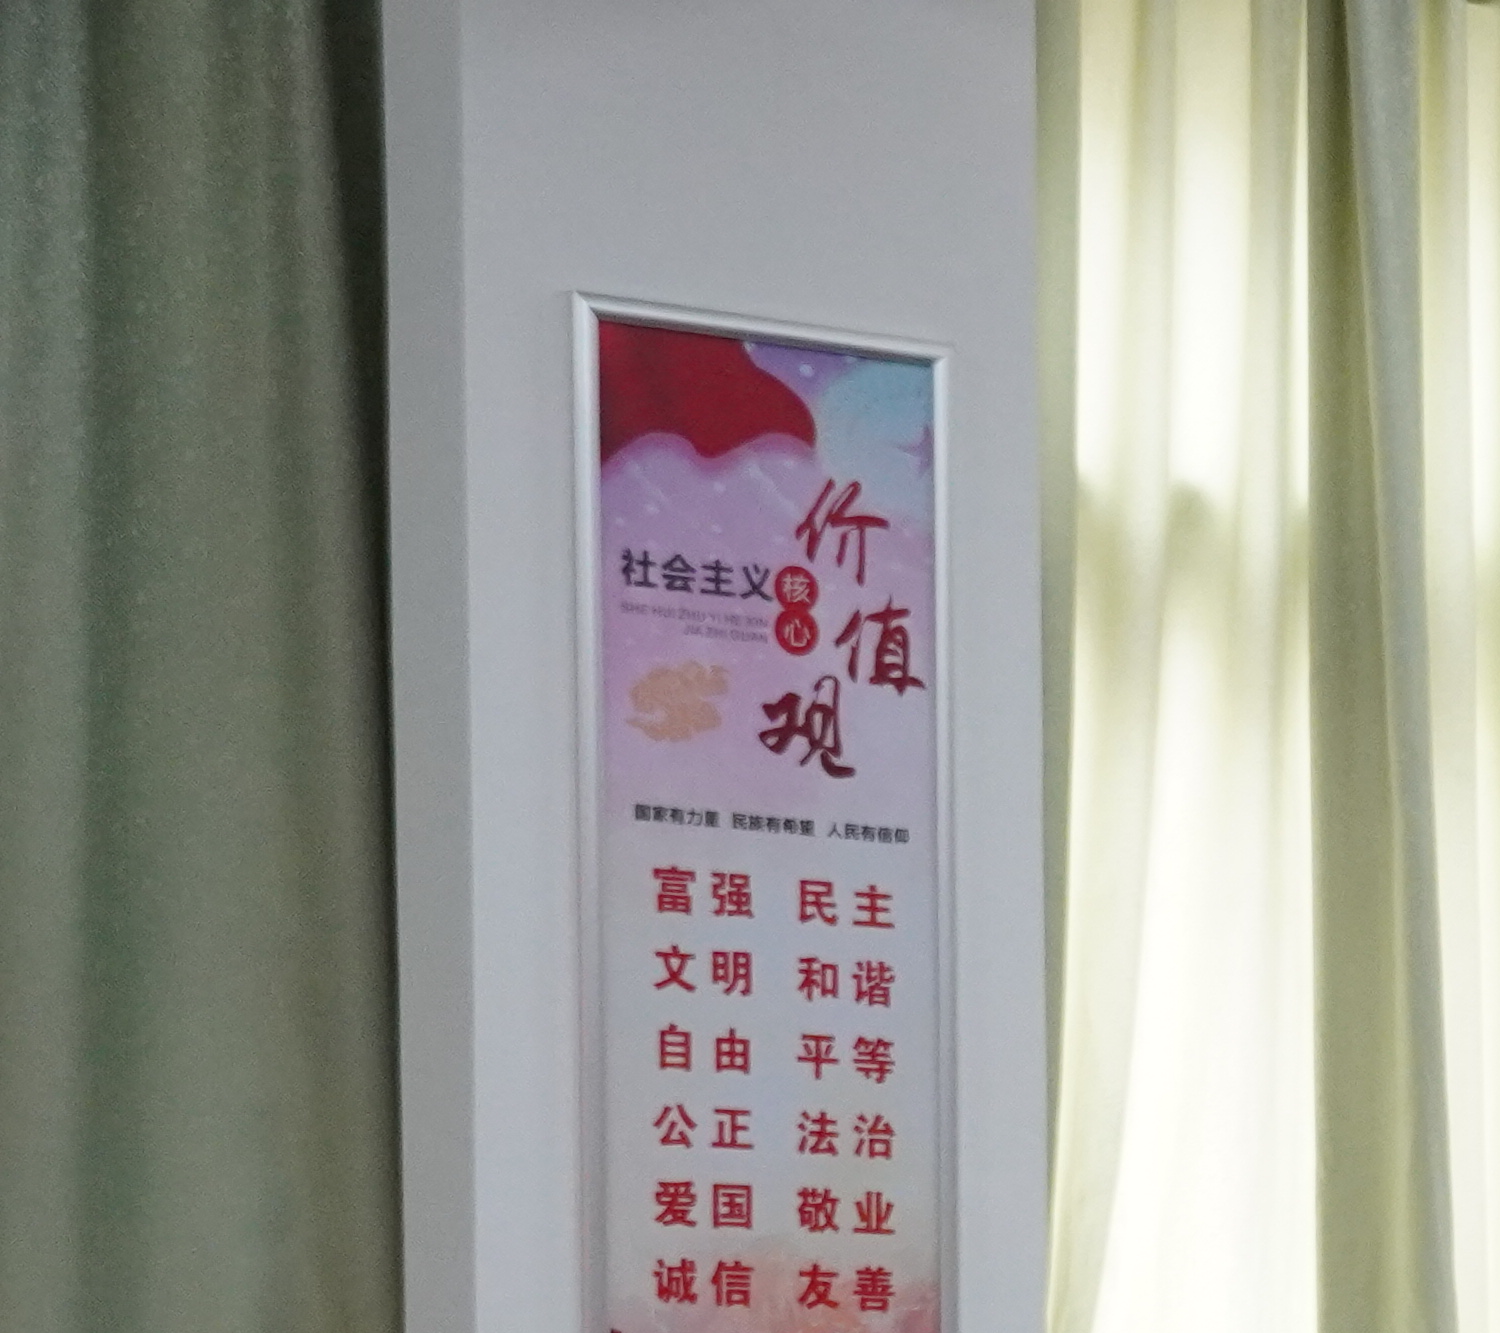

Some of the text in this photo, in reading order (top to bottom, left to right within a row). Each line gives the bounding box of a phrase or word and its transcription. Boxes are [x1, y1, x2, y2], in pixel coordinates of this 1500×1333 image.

[621, 548, 773, 602] 社会主义
[635, 804, 720, 828] 国家有力量
[826, 823, 910, 844] 人民有信仰
[653, 866, 896, 930] 富强 民主
[655, 945, 896, 1008] 文明 和谐
[657, 1023, 896, 1085] 自由 平等
[652, 1103, 896, 1161] 公正 法治
[652, 1179, 896, 1237] 爱国 敬业
[652, 1258, 896, 1313] 诚信 友善
